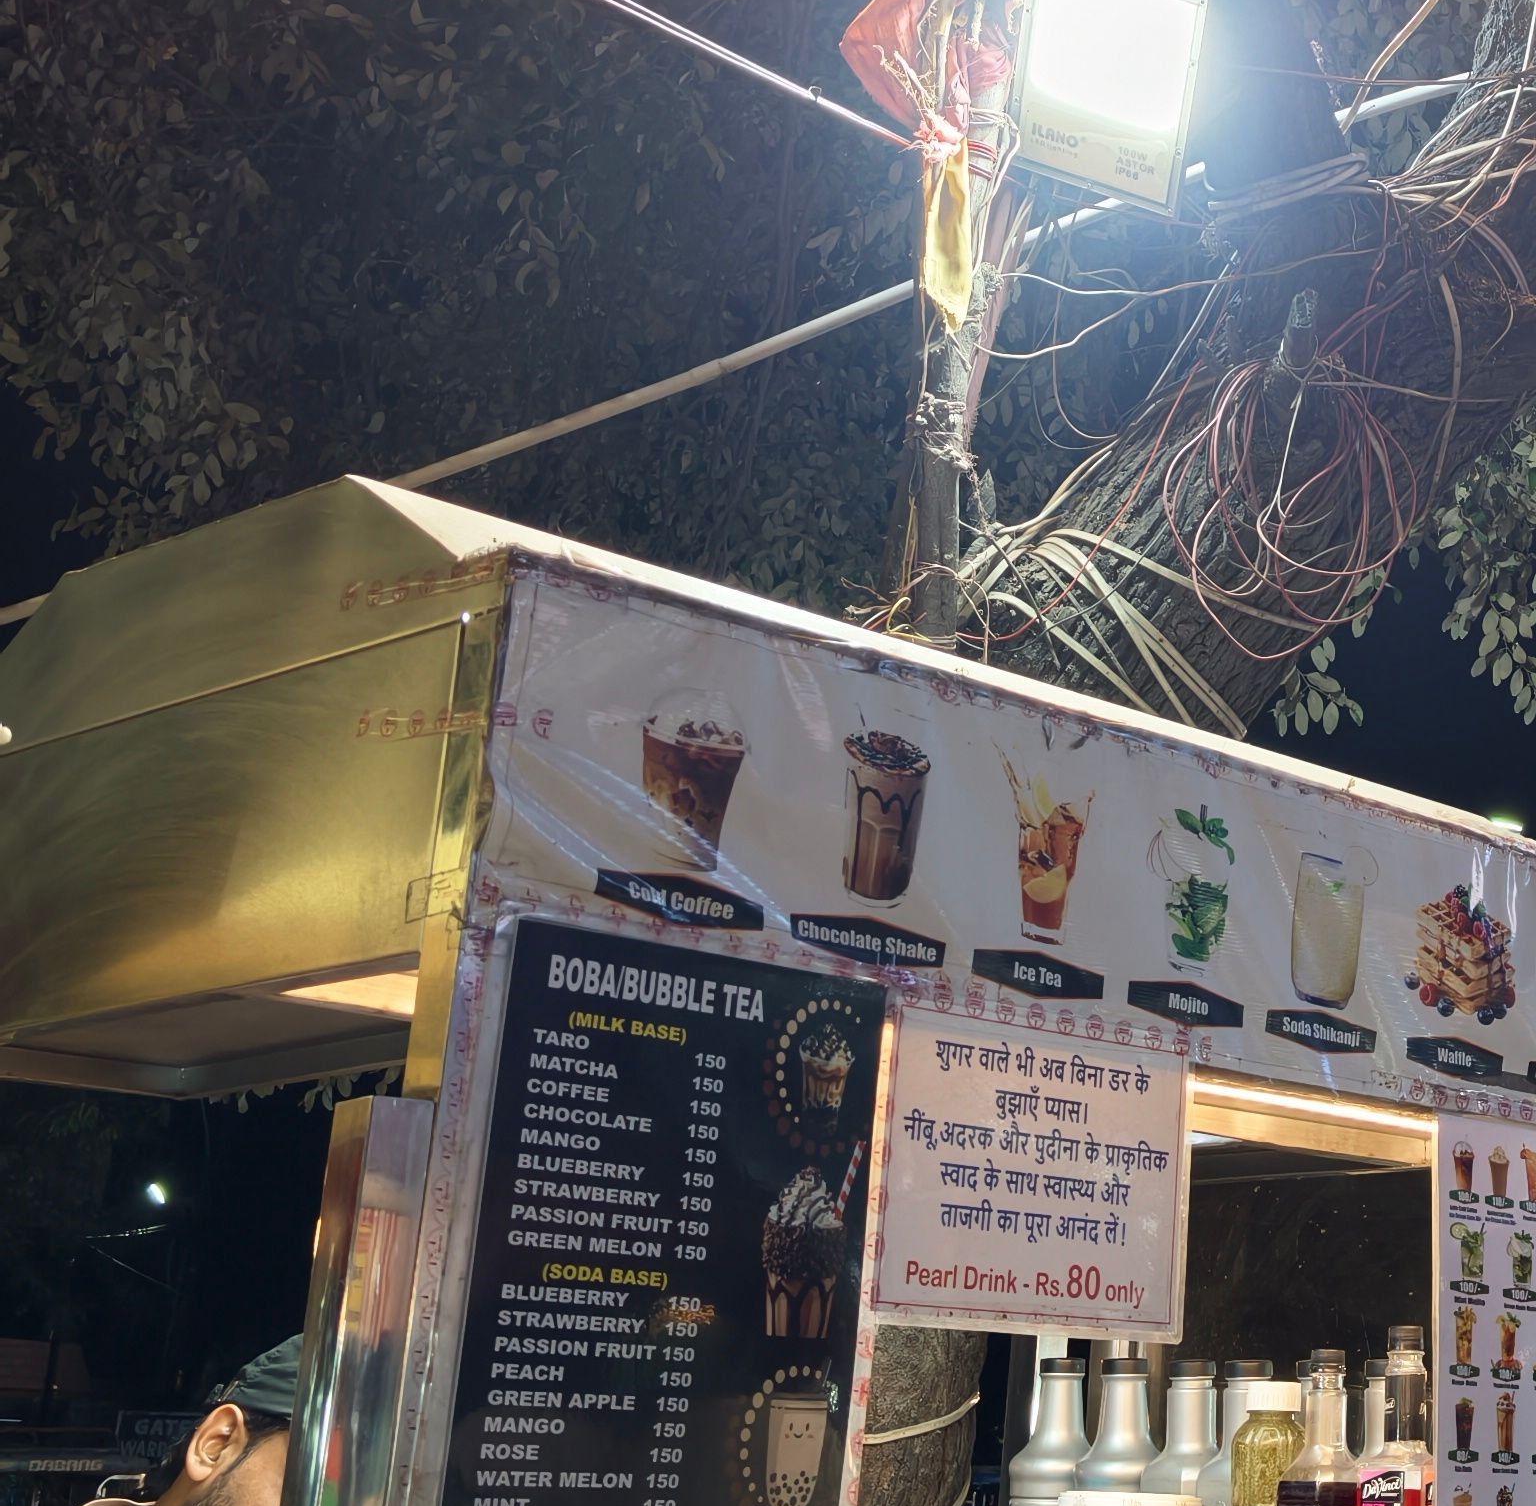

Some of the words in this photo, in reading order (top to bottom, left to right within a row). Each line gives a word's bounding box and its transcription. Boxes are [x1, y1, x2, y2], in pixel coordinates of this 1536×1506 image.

[670, 891, 734, 921] Coffee
[798, 919, 882, 953] Chocolate
[885, 935, 937, 962] Shake
[548, 954, 717, 1014] BOBA/BUBBLE
[723, 983, 765, 1022] TEA
[1013, 961, 1036, 982] Ice
[1038, 964, 1062, 988] Tea
[1168, 993, 1209, 1016] Mojito
[568, 1011, 626, 1035] (MILK
[631, 1020, 688, 1045] BASE)
[1282, 1015, 1311, 1037] Soda
[1312, 1018, 1361, 1048] Shikanji
[533, 1028, 590, 1050] TARO
[695, 1053, 727, 1070] 150
[936, 1039, 975, 1072] शुगर
[979, 1042, 1011, 1074] वाले
[1015, 1046, 1035, 1077] भी
[1040, 1056, 1066, 1083] अब
[1071, 1055, 1104, 1089] बिना
[1108, 1067, 1132, 1093] डर
[1135, 1064, 1151, 1095] के
[1437, 1047, 1473, 1068] Waffle
[529, 1053, 619, 1080] MATCHA
[692, 1076, 724, 1094] 150
[526, 1078, 610, 1103] COFFEE
[689, 1100, 721, 1117] 150
[523, 1103, 653, 1133] CHOCOLATE
[687, 1124, 719, 1141] 150
[1000, 1120, 1031, 1155] और
[1035, 1128, 1081, 1165] पुदीना
[1084, 1132, 1101, 1162] के
[1105, 1140, 1169, 1175] प्राकृतिक
[940, 1160, 980, 1192] स्वाद
[983, 1158, 1001, 1191] के
[1005, 1169, 1038, 1196] साथ
[1043, 1174, 1097, 1202] स्वास्थ्य
[1101, 1173, 1131, 1207] और
[940, 1199, 993, 1231] ताजगी
[997, 1209, 1020, 1234] का
[1024, 1211, 1051, 1243] पूरा
[1055, 1213, 1100, 1245] आनंद
[542, 1263, 604, 1284] (SODA
[610, 1270, 669, 1291] BASE)
[906, 1260, 957, 1289] Pearl
[963, 1266, 1017, 1294] Drink
[1035, 1264, 1101, 1300] Rs.80
[1105, 1280, 1144, 1309] only
